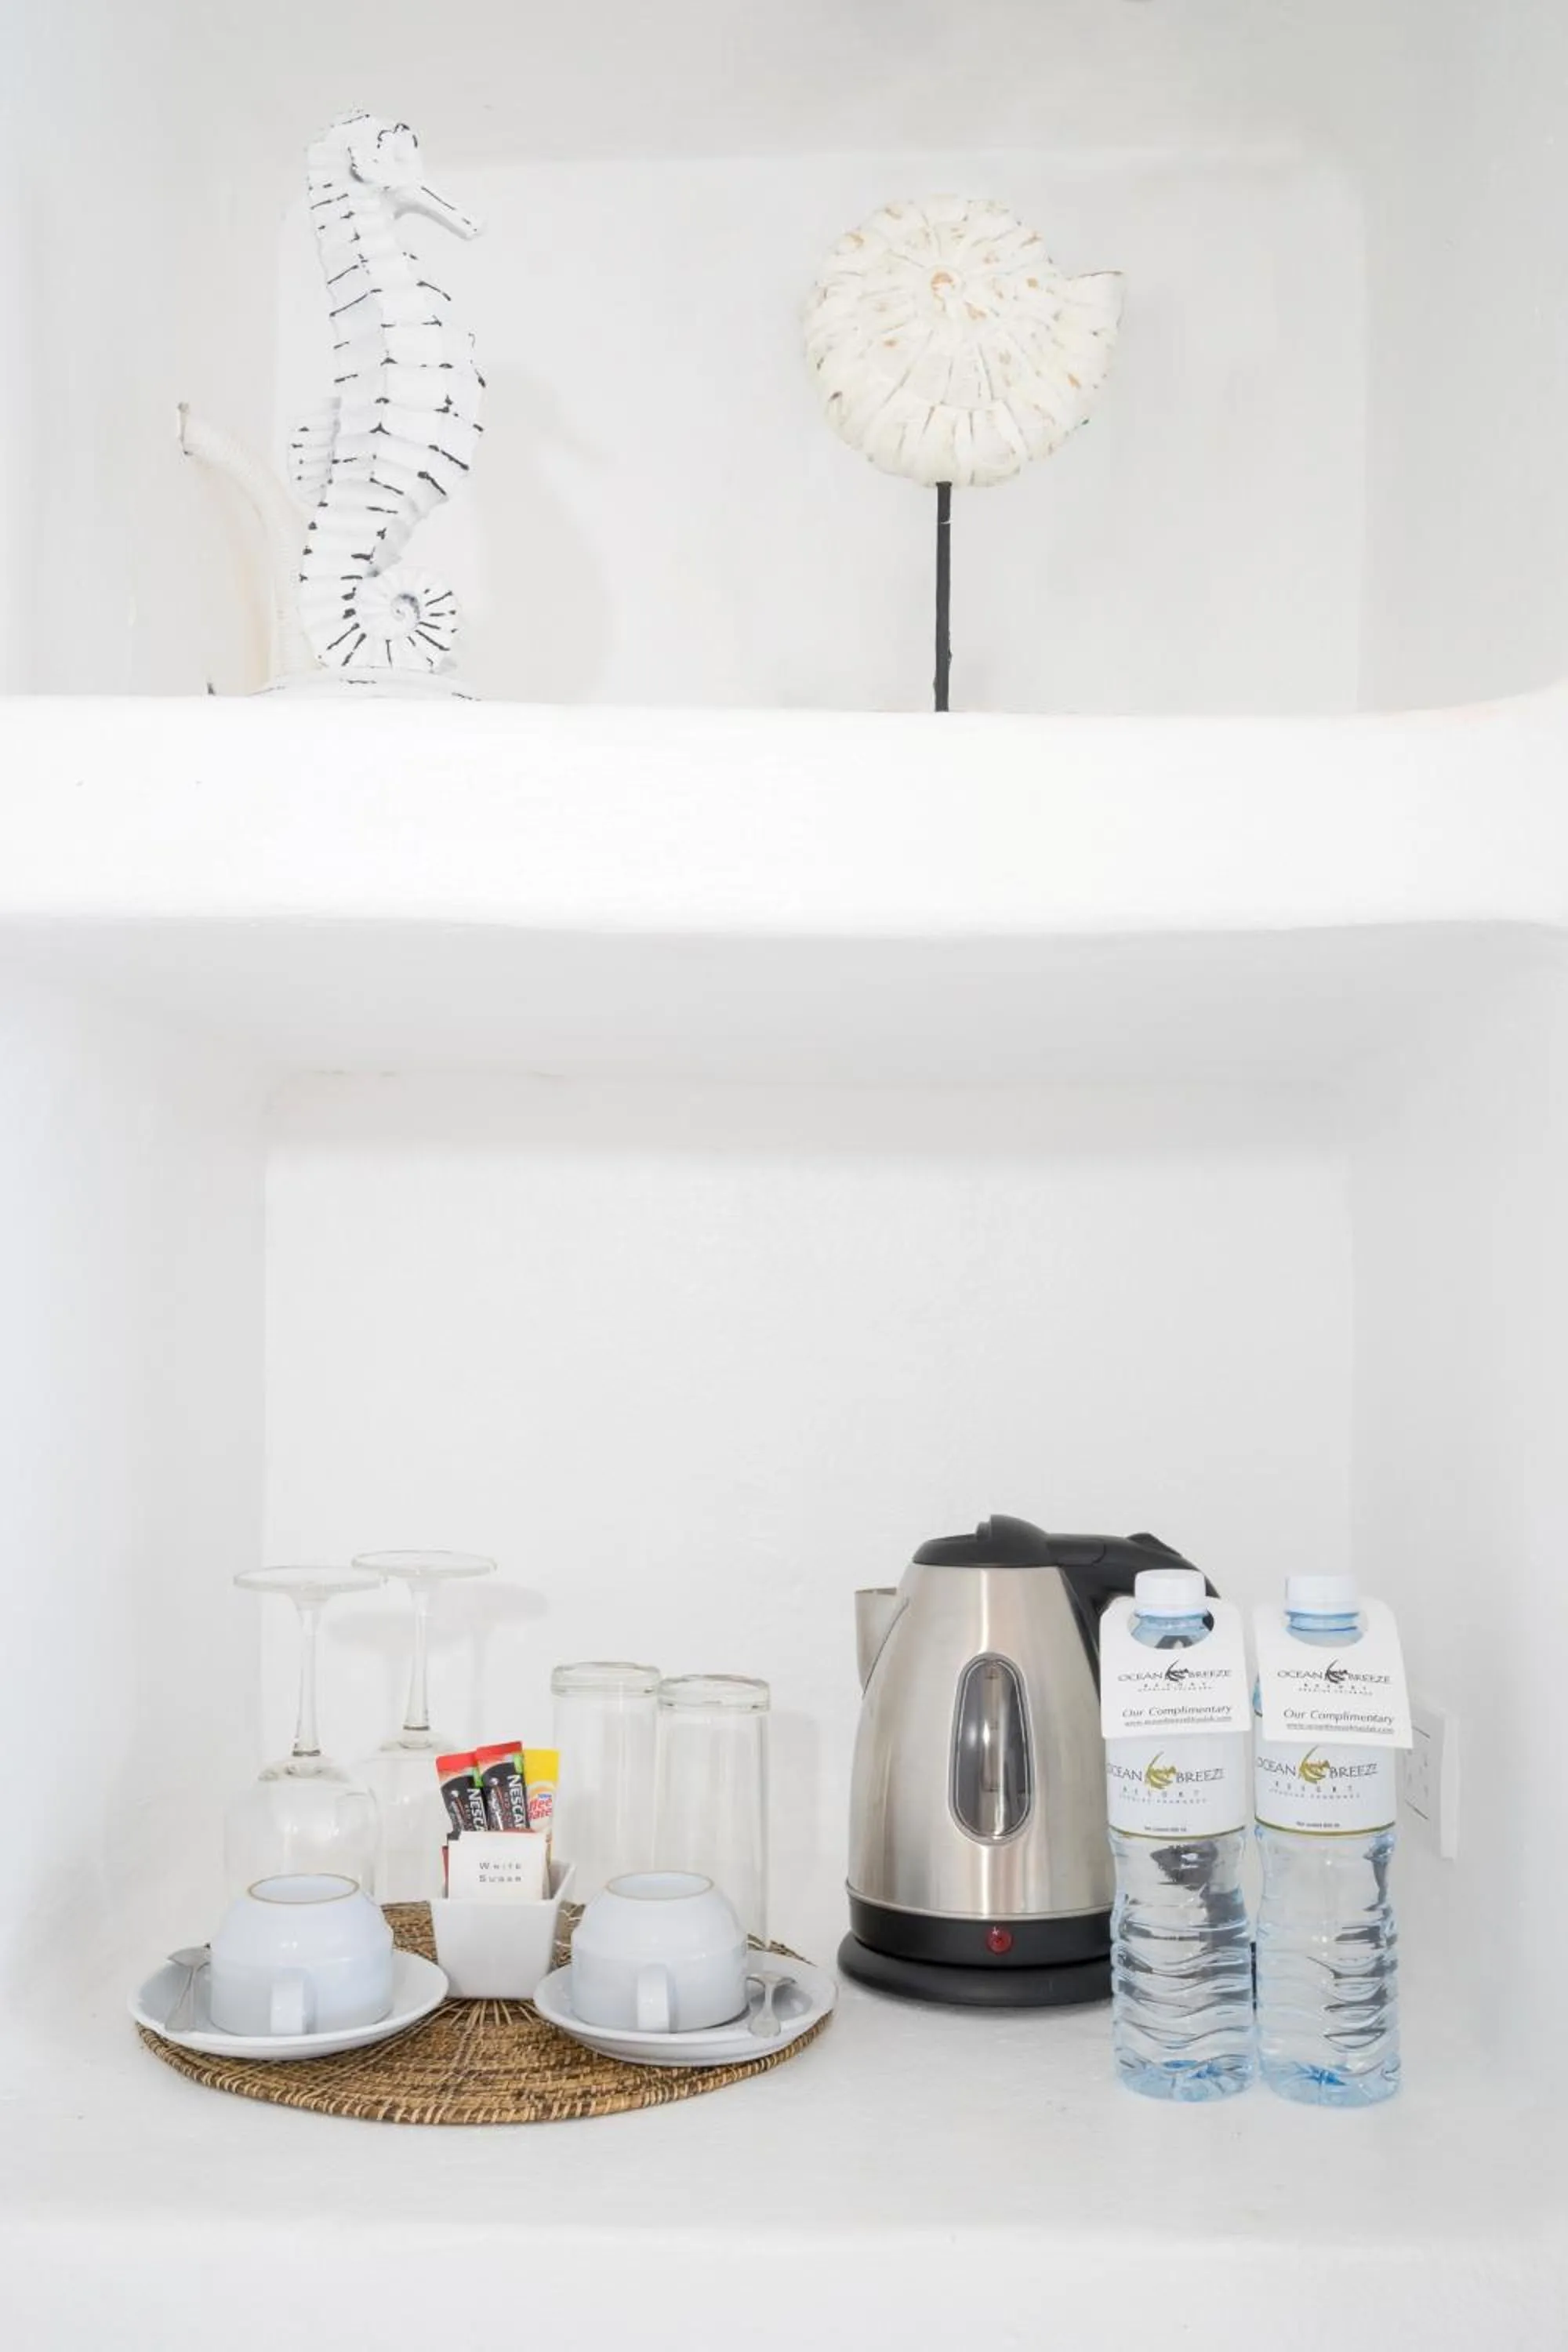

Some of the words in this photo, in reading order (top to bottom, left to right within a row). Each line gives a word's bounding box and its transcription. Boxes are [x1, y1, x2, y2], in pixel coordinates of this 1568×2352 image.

[1117, 1671, 1163, 1682] OCEAN
[1277, 1669, 1323, 1680] OCEAN
[1149, 1704, 1232, 1717] Complimentary
[1283, 1708, 1305, 1719] Our
[1310, 1709, 1395, 1726] Complimentary
